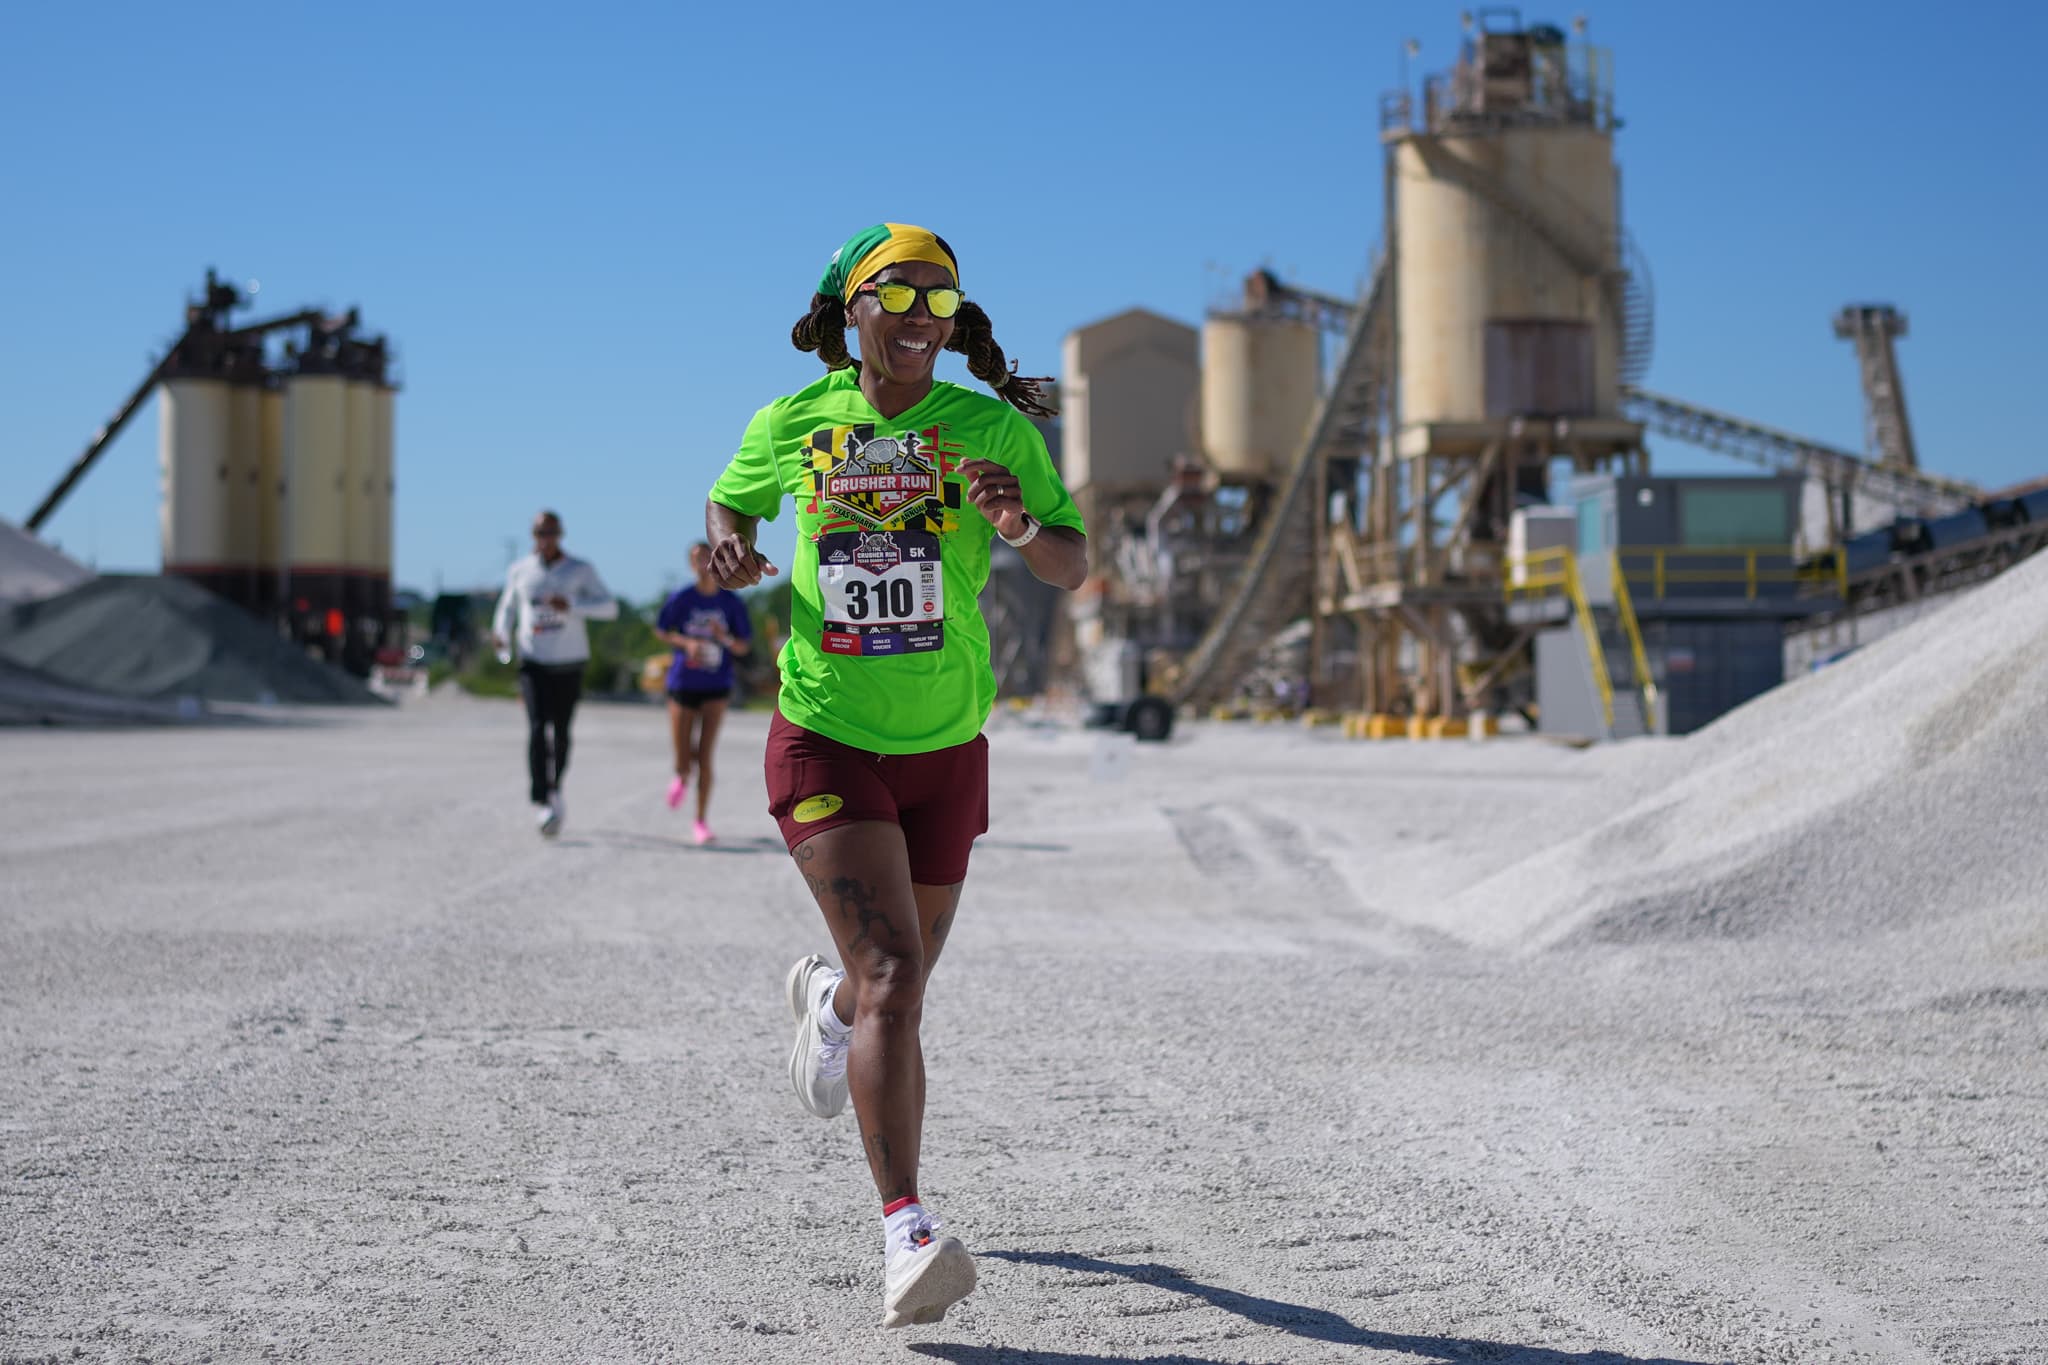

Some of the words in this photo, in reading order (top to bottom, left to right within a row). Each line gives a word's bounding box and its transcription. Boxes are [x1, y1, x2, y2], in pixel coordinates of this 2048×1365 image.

[869, 463, 892, 475] THE
[831, 476, 896, 492] CRUSHER
[901, 475, 930, 489] RUN
[831, 505, 851, 518] TEXAS
[850, 514, 877, 530] QUARRY
[901, 504, 928, 521] ANNUAL
[909, 547, 926, 558] 5K
[845, 578, 914, 620] 310
